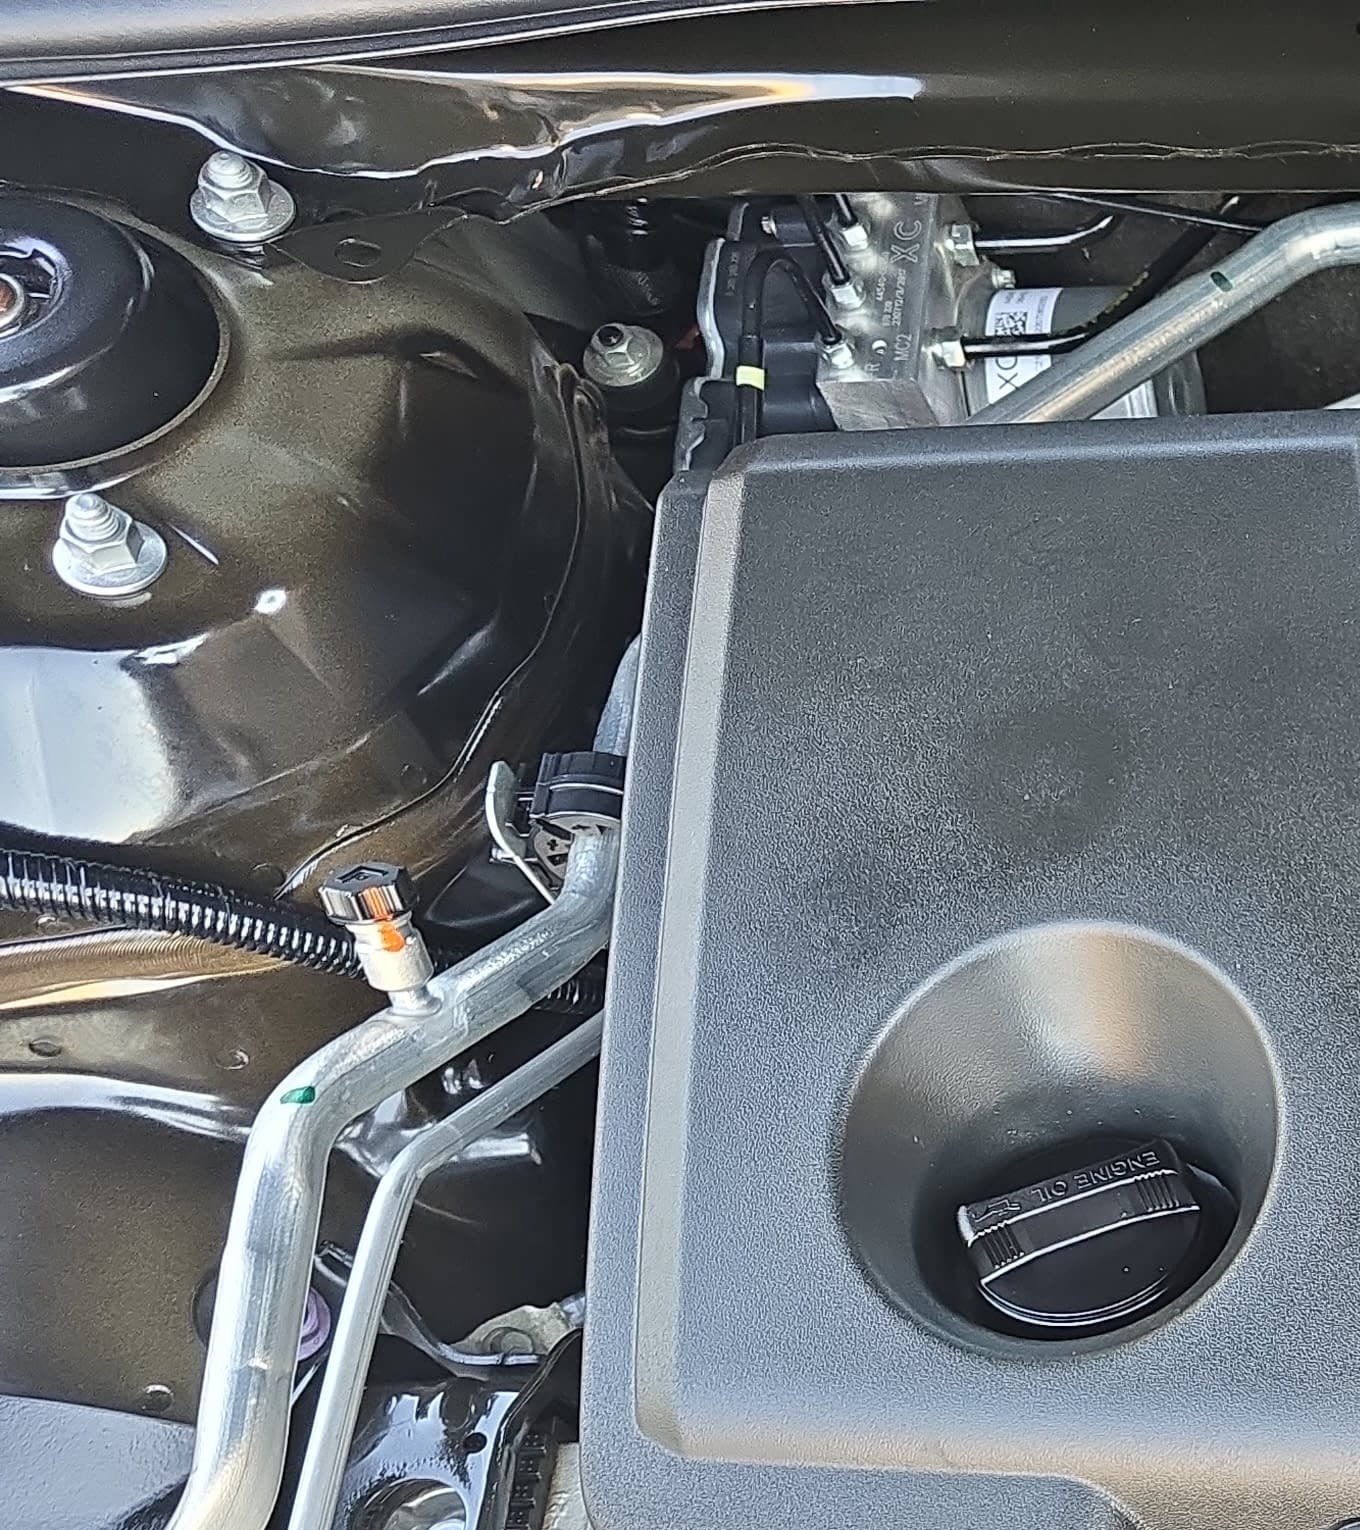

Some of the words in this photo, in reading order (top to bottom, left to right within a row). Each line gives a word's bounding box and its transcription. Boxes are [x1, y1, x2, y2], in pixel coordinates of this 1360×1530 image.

[894, 333, 912, 361] MC2
[1073, 1150, 1160, 1190] ENGINE
[1031, 1180, 1069, 1204] OIL
